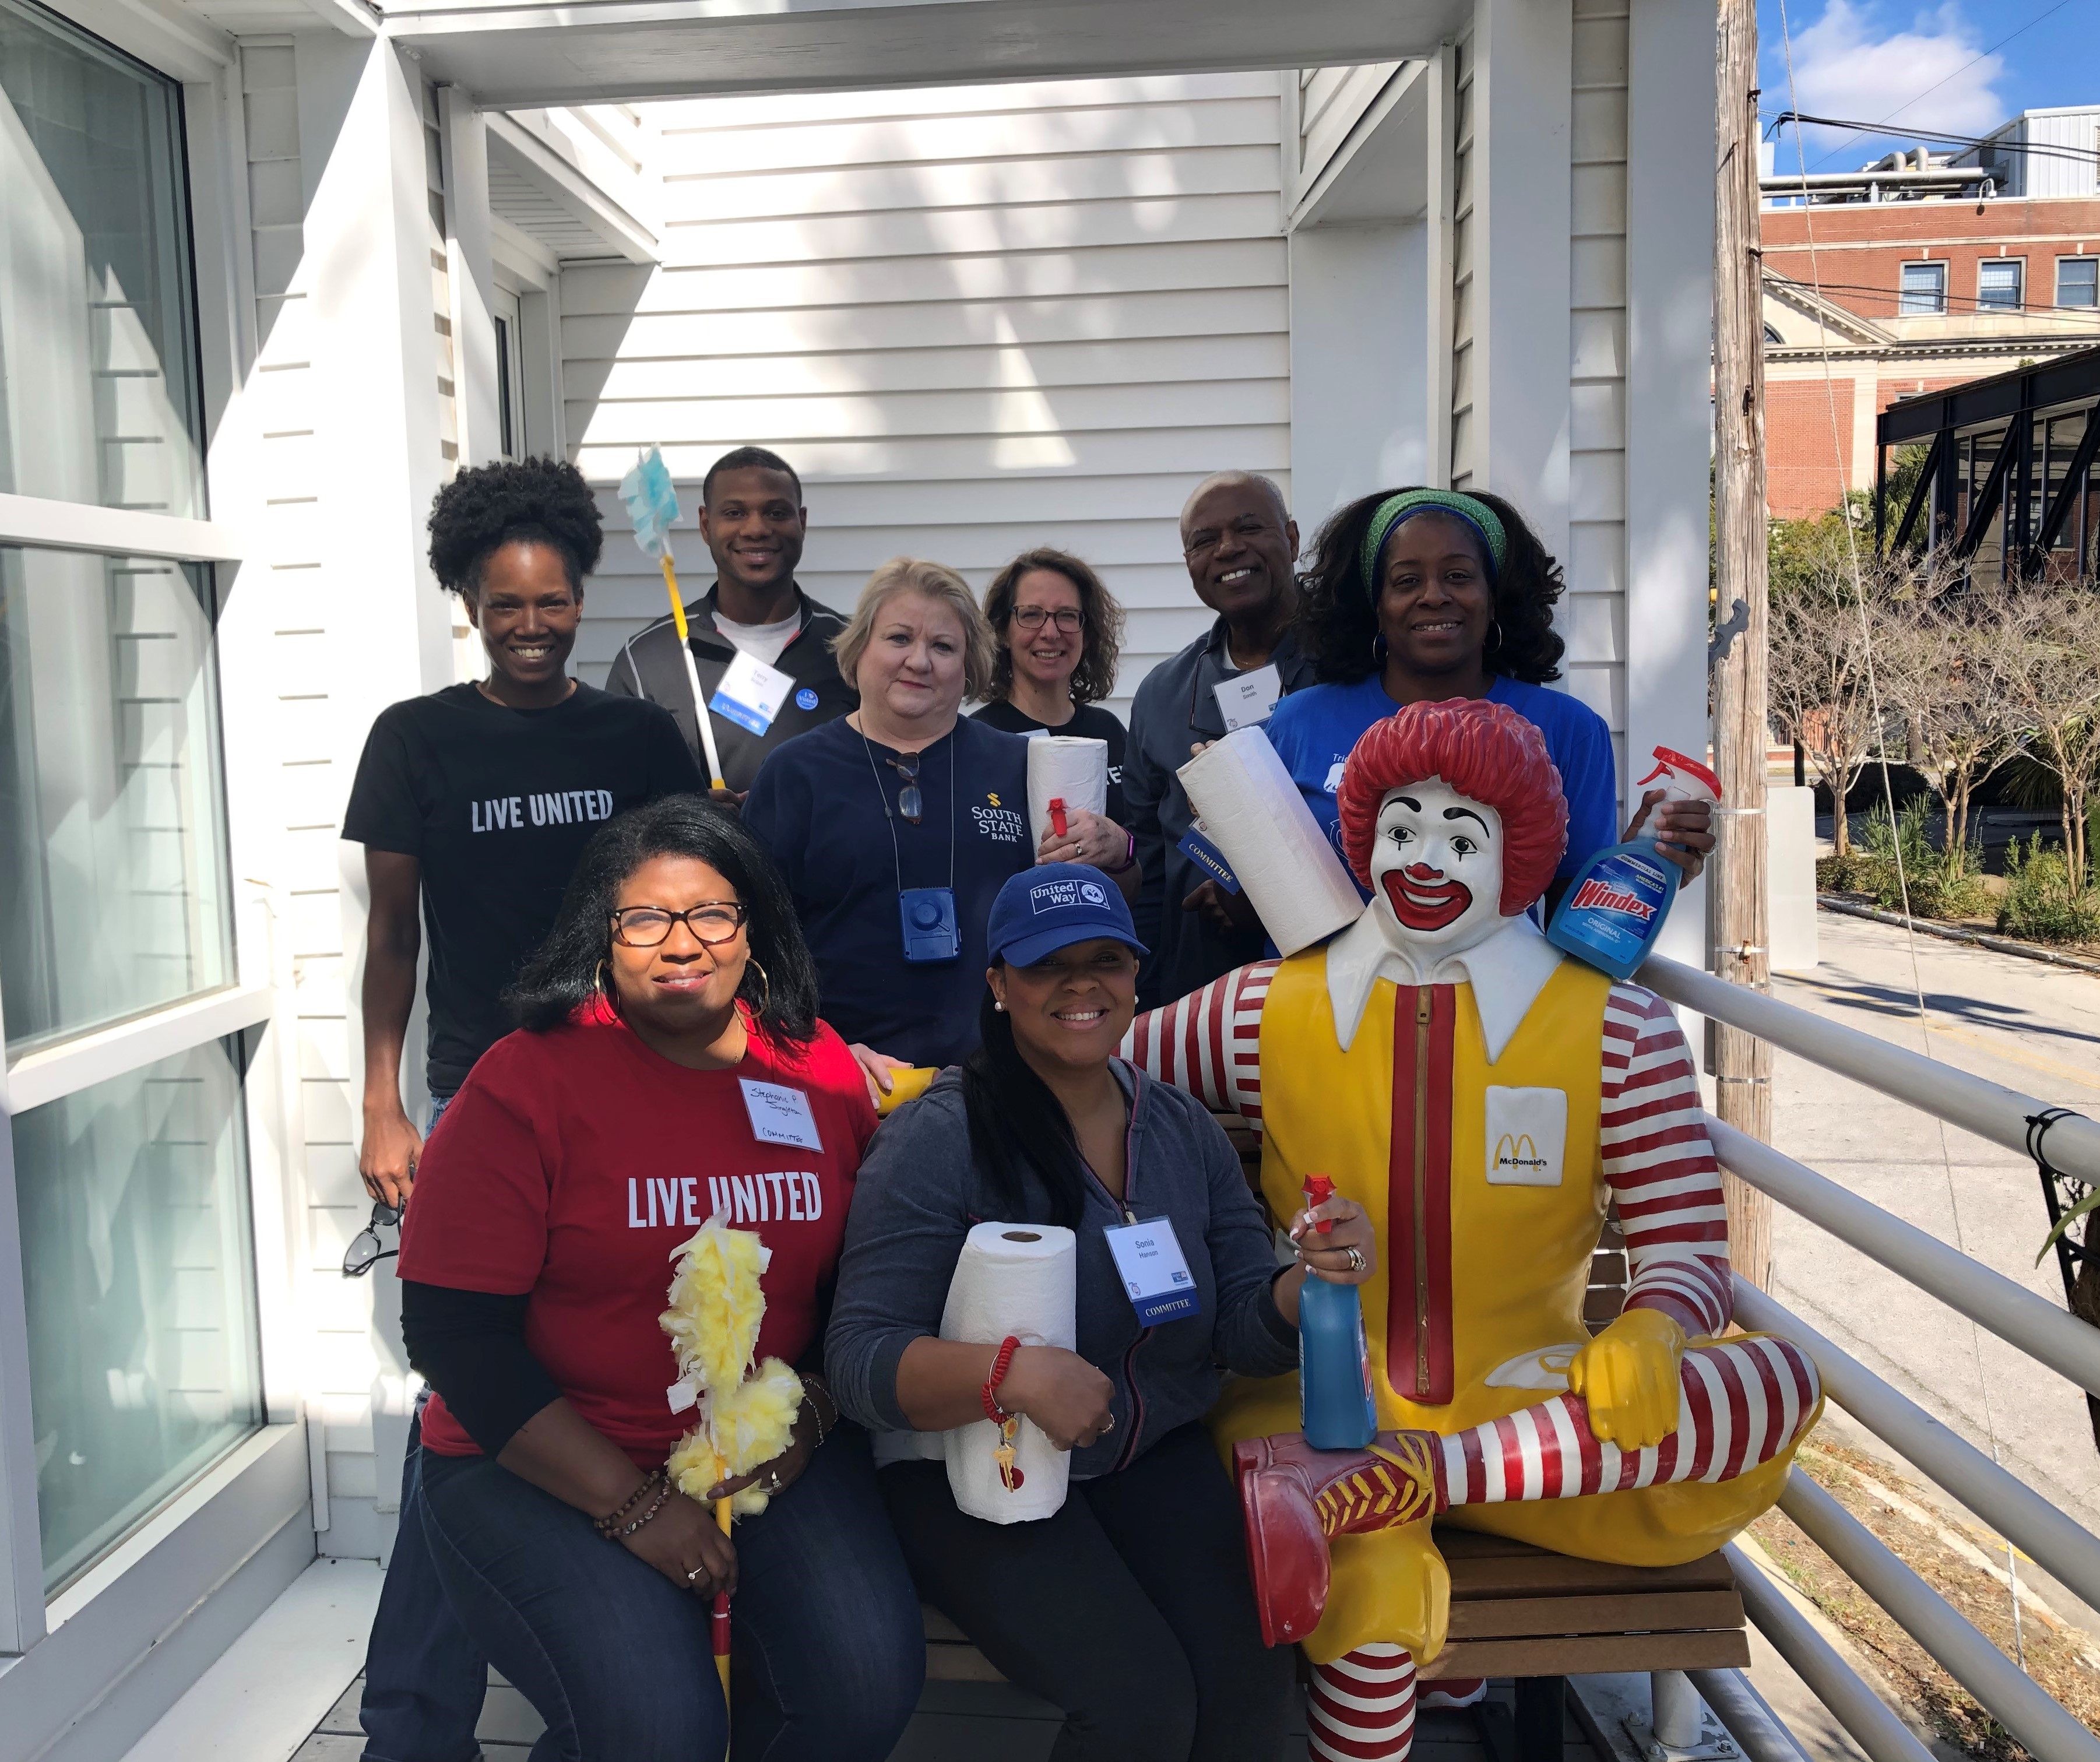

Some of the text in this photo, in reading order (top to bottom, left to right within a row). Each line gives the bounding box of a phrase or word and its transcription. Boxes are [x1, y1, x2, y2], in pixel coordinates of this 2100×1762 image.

[1241, 684, 1254, 693] Don
[1243, 691, 1257, 699] Smith
[472, 789, 613, 832] LIVE UNITED
[971, 806, 1023, 825] SOUTH
[979, 820, 1023, 836] STATE
[991, 832, 1018, 843] BANK
[1188, 843, 1233, 883] COMMITTEE
[1620, 856, 1651, 874] COMMERCIAL
[1032, 882, 1075, 899] United
[1050, 893, 1077, 904] Way
[1571, 879, 1656, 920] Windex
[1588, 917, 1621, 939] ORIGINAL
[1499, 1158, 1547, 1166] McDonald's
[628, 1172, 822, 1228] LIVE UNITED
[1135, 1239, 1155, 1248] Sonia
[1138, 1250, 1159, 1258] Hanson
[1145, 1298, 1191, 1317] COMMITTEE
